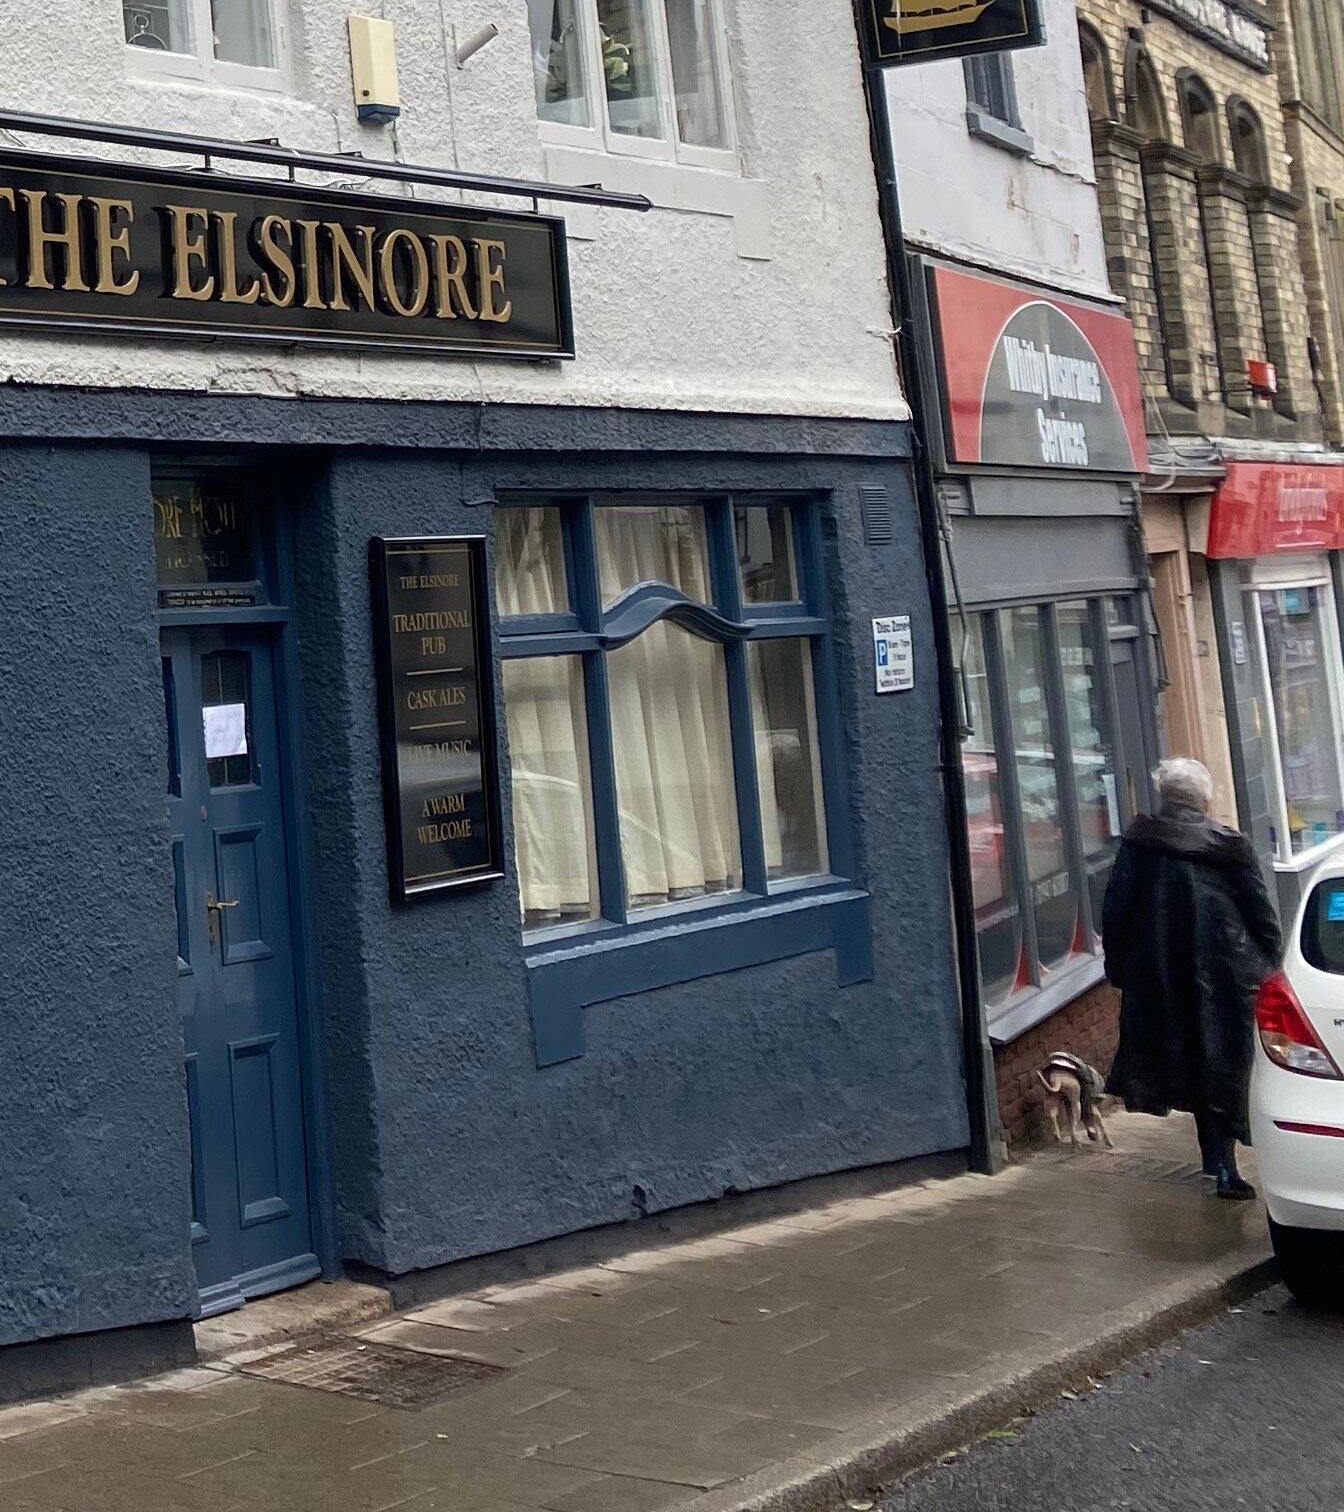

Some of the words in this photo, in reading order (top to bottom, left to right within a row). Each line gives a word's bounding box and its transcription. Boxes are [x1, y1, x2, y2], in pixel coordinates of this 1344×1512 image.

[166, 203, 512, 323] ELSINORE
[1037, 407, 1089, 466] Services
[399, 575, 418, 589] THE
[419, 574, 460, 588] ELSINORE
[392, 609, 471, 632] TRADITIONAL
[421, 636, 446, 656] PUB
[407, 688, 437, 710] CASK
[439, 686, 466, 706] ALES
[434, 739, 472, 760] MUSIC
[422, 799, 431, 817] A
[431, 794, 466, 815] WARM
[417, 818, 473, 845] WELCOME
